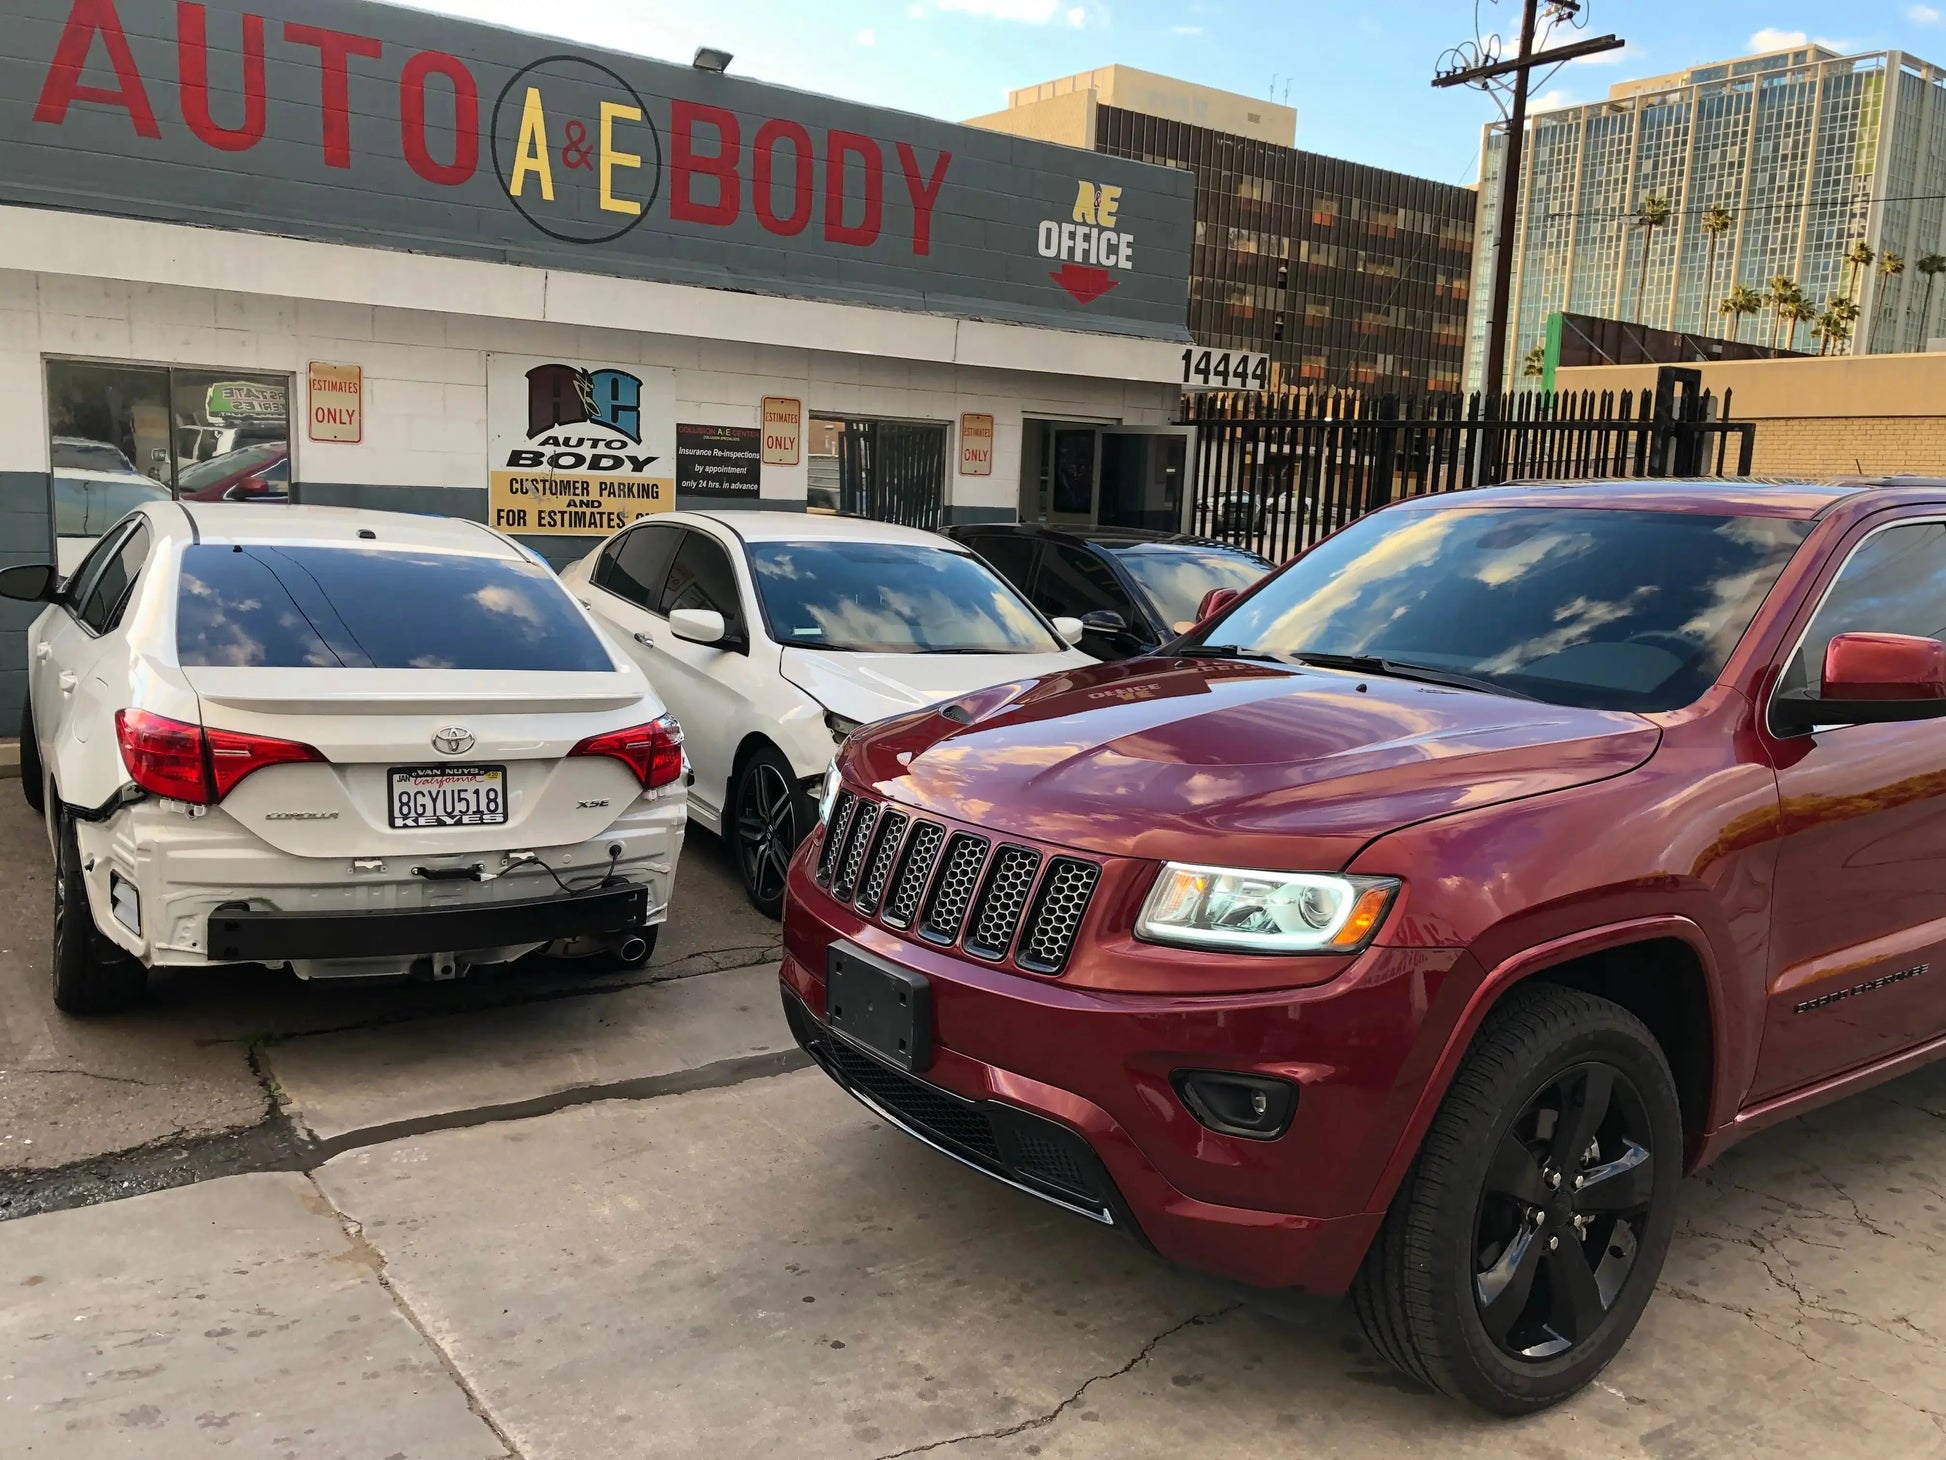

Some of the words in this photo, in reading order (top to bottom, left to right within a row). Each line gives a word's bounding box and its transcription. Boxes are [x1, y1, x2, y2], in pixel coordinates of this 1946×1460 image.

[32, 0, 480, 187] AUTO
[510, 87, 555, 201] A
[562, 120, 593, 171] &
[599, 101, 642, 215] E
[670, 99, 952, 256] BODY
[1038, 220, 1134, 269] OFFICE
[1182, 349, 1268, 390] 14444
[312, 378, 358, 394] ESTIMATES
[314, 407, 356, 426] ONLY
[765, 411, 798, 425] ESTIMATES
[963, 426, 991, 439] ESTIMATES
[537, 435, 629, 451] AUTO
[766, 434, 796, 451] ONLY
[678, 446, 712, 457] Insurance
[713, 448, 760, 459] Re-inspections
[964, 449, 989, 463] ONLY
[506, 449, 660, 473] BODY
[694, 463, 704, 474] by
[705, 465, 747, 475] appointment
[509, 477, 590, 497] CUSTOMER
[599, 481, 660, 500] PARKING
[681, 480, 697, 489] only
[698, 480, 707, 488] 24
[708, 481, 721, 489] hrs.
[722, 481, 730, 489] in
[730, 482, 758, 491] advance
[566, 499, 602, 509] AND
[496, 509, 527, 527] FOR
[537, 510, 626, 529] ESTIMATES
[396, 773, 411, 783] JAN
[416, 768, 441, 776] VAN
[413, 775, 485, 789] California
[398, 787, 500, 817] 8GYU518
[576, 799, 610, 810] XSE
[265, 810, 339, 821] COROLLA
[394, 813, 504, 827] KEYES
